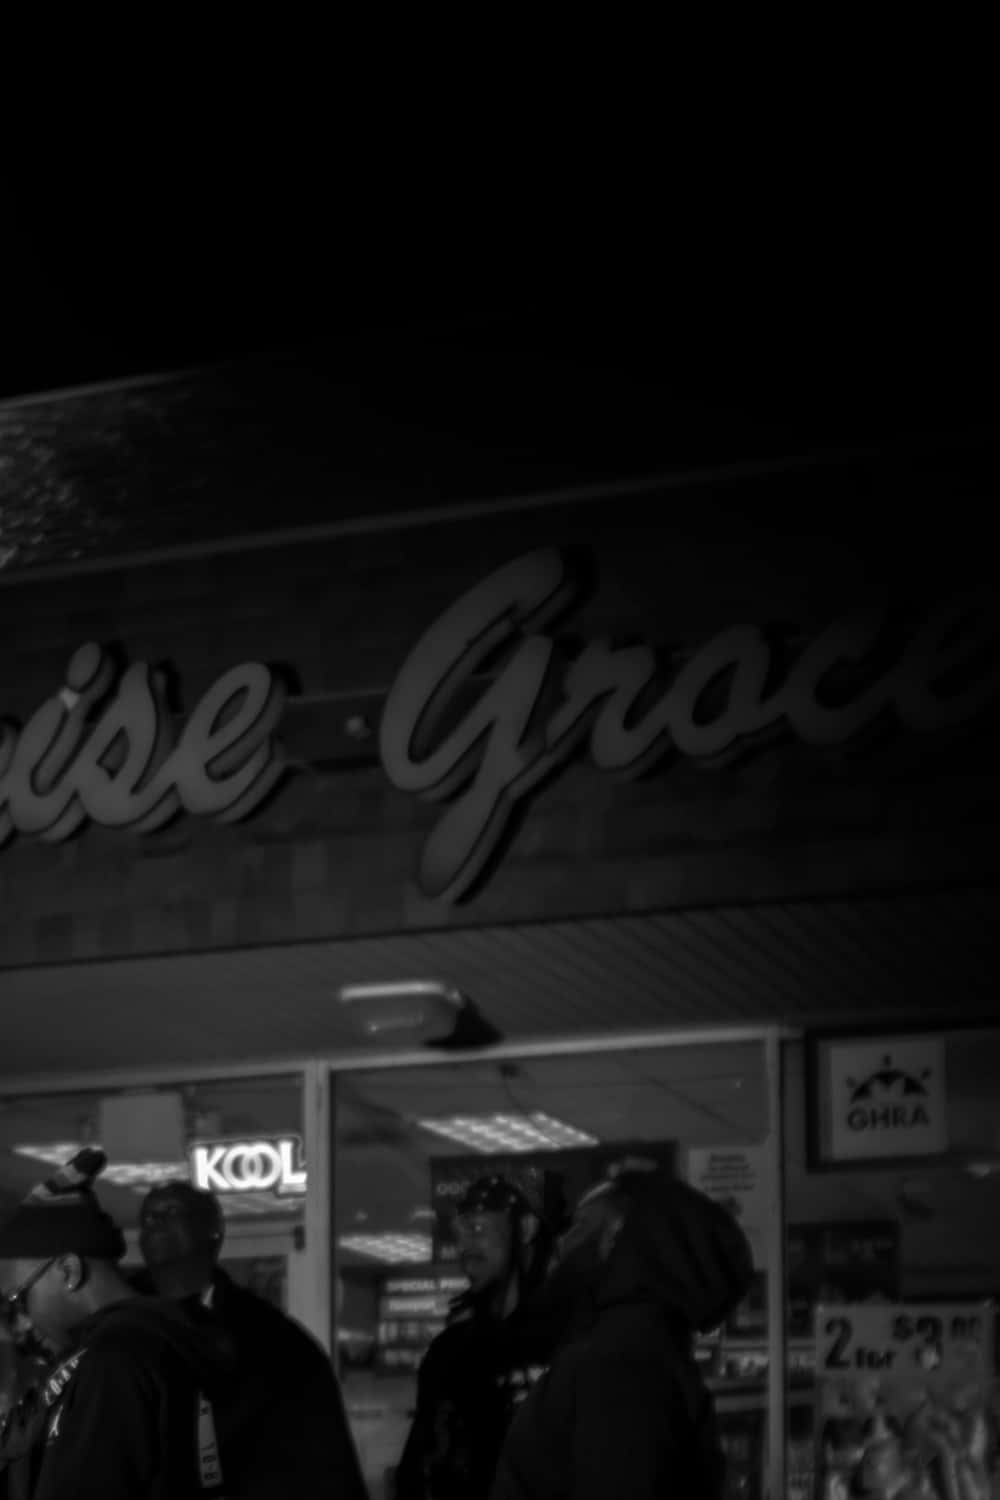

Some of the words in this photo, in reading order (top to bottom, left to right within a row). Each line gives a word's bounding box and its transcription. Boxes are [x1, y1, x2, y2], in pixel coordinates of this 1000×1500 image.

[846, 1105, 931, 1131] GHRA
[194, 1140, 307, 1190] KOOL
[824, 1316, 853, 1369] 2
